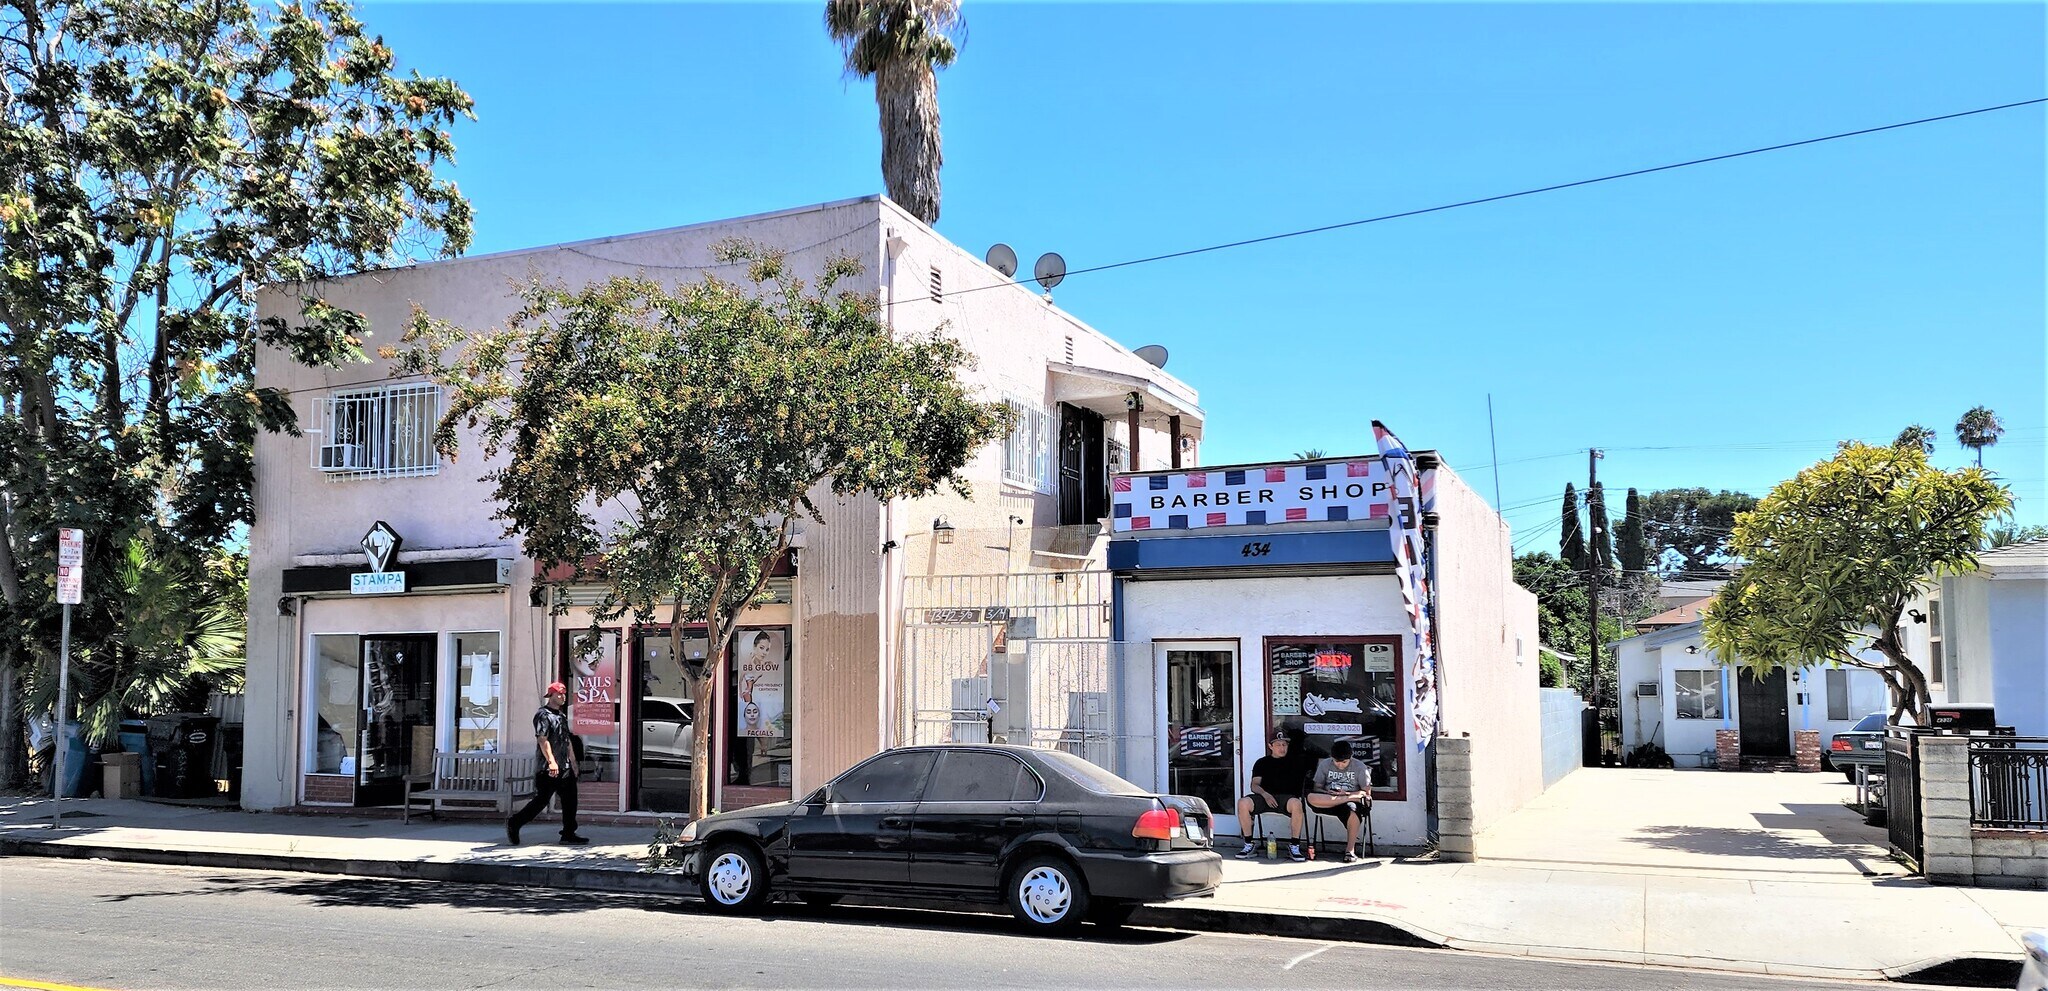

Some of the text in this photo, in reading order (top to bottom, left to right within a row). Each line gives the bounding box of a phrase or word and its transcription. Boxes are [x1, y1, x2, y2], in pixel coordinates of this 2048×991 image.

[1151, 482, 1386, 509] BARBER SHOP
[61, 530, 70, 539] NO
[1241, 542, 1271, 557] 434
[60, 567, 68, 576] NO
[353, 574, 402, 585] STAMPA
[755, 663, 779, 672] GLOW
[577, 676, 611, 688] NAILS
[577, 688, 611, 703] SPA
[1305, 725, 1324, 733] (323)
